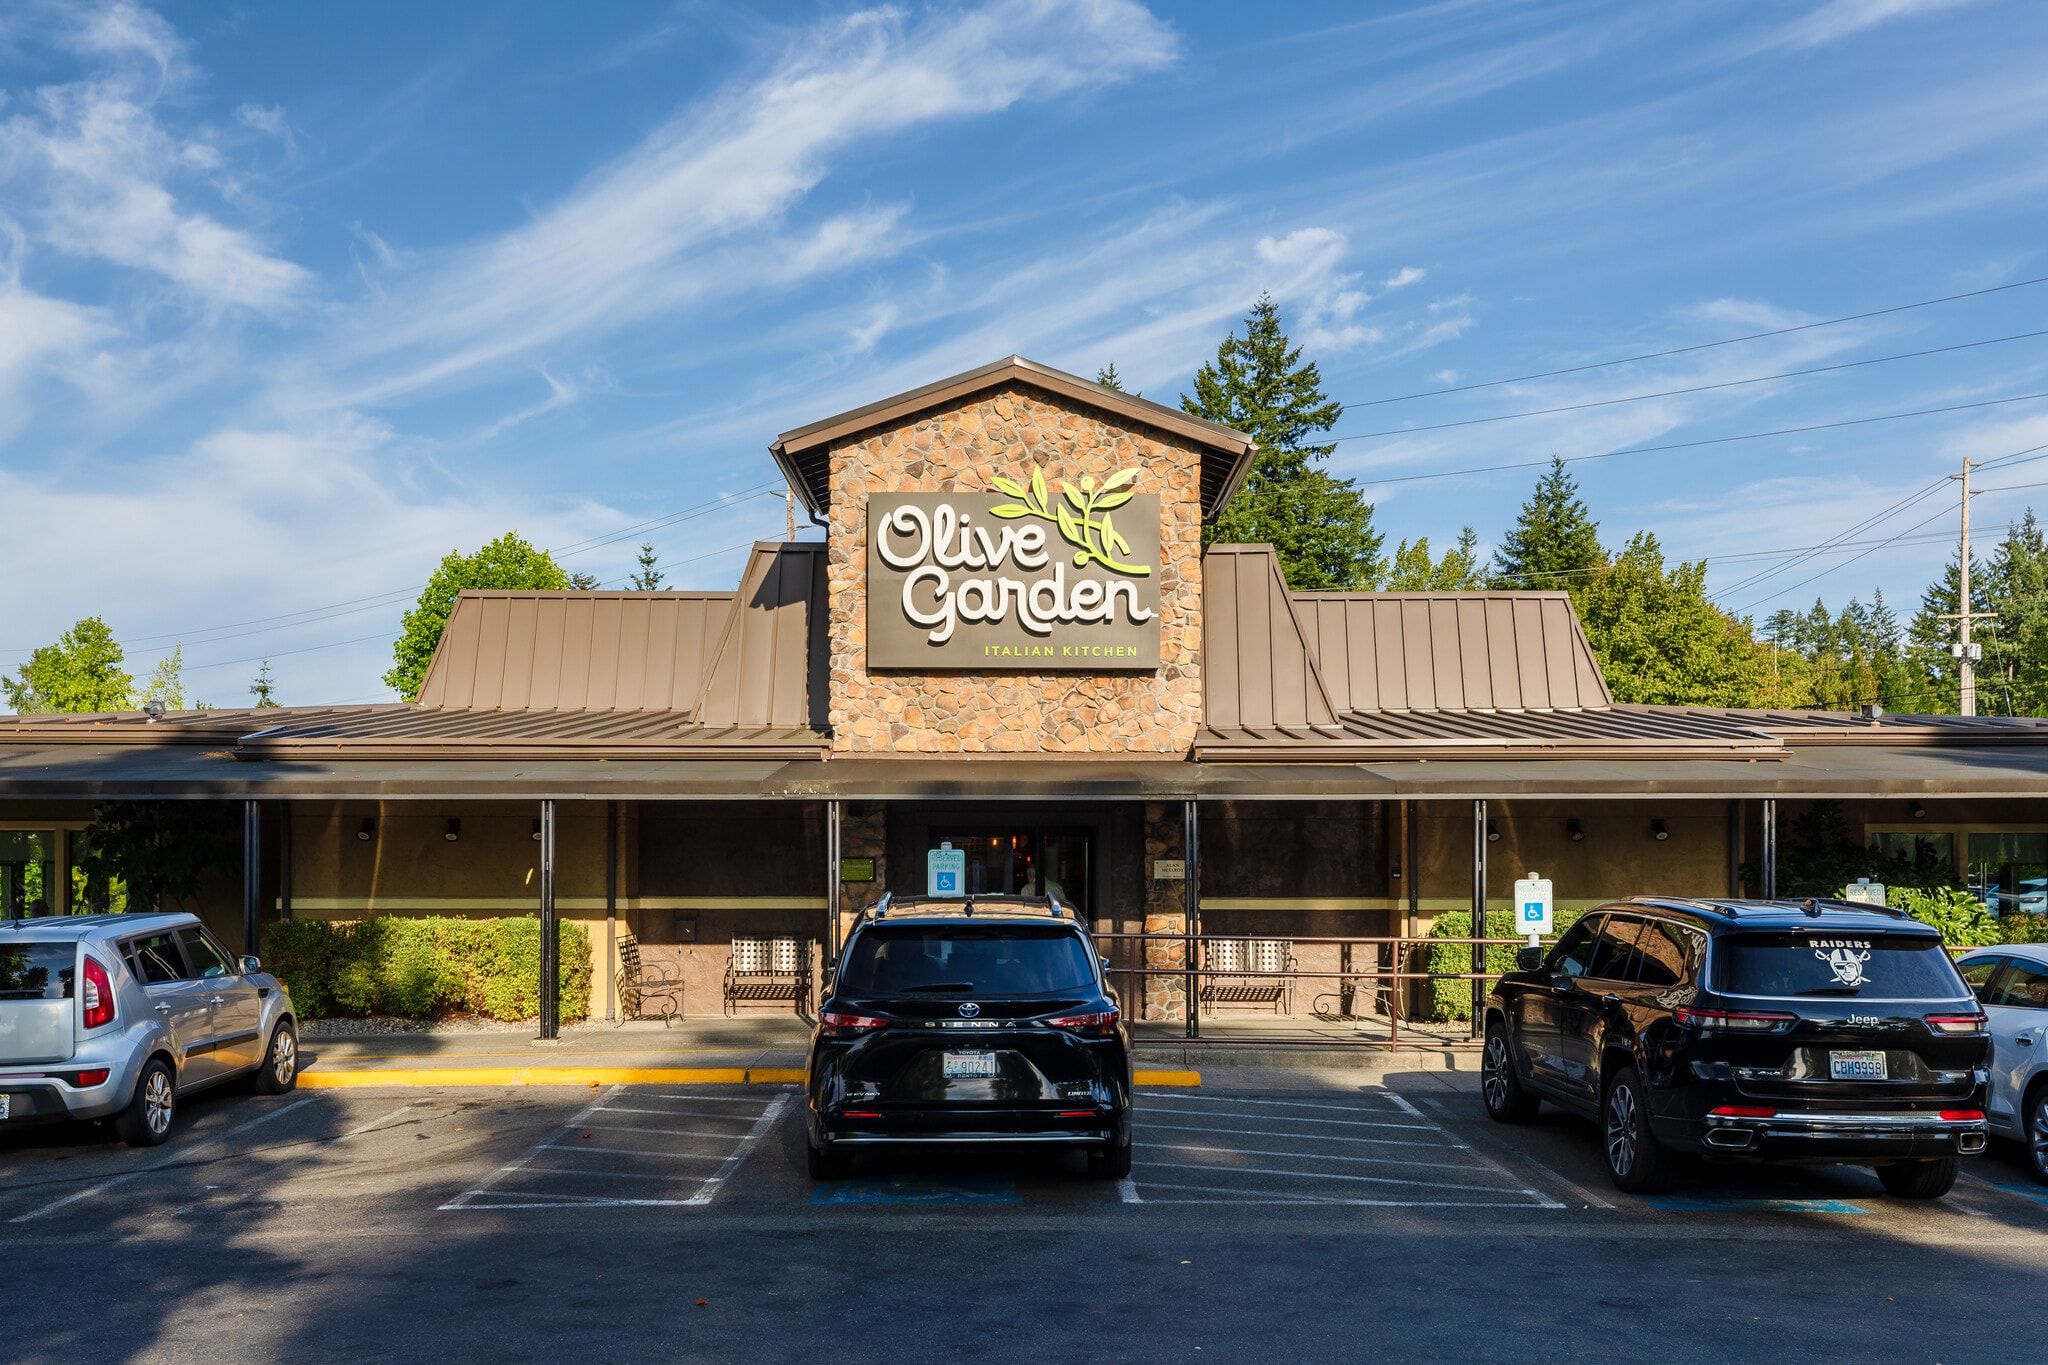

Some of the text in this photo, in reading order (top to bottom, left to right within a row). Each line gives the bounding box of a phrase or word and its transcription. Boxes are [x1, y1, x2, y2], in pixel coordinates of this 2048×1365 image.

[877, 503, 1050, 568] Olive
[902, 561, 1153, 643] Garden
[984, 645, 1138, 657] ITALIAN KITCHEN
[1809, 940, 1872, 949] RAIDERS
[1846, 1013, 1879, 1026] Jeep
[1833, 1060, 1882, 1075] CBH9998
